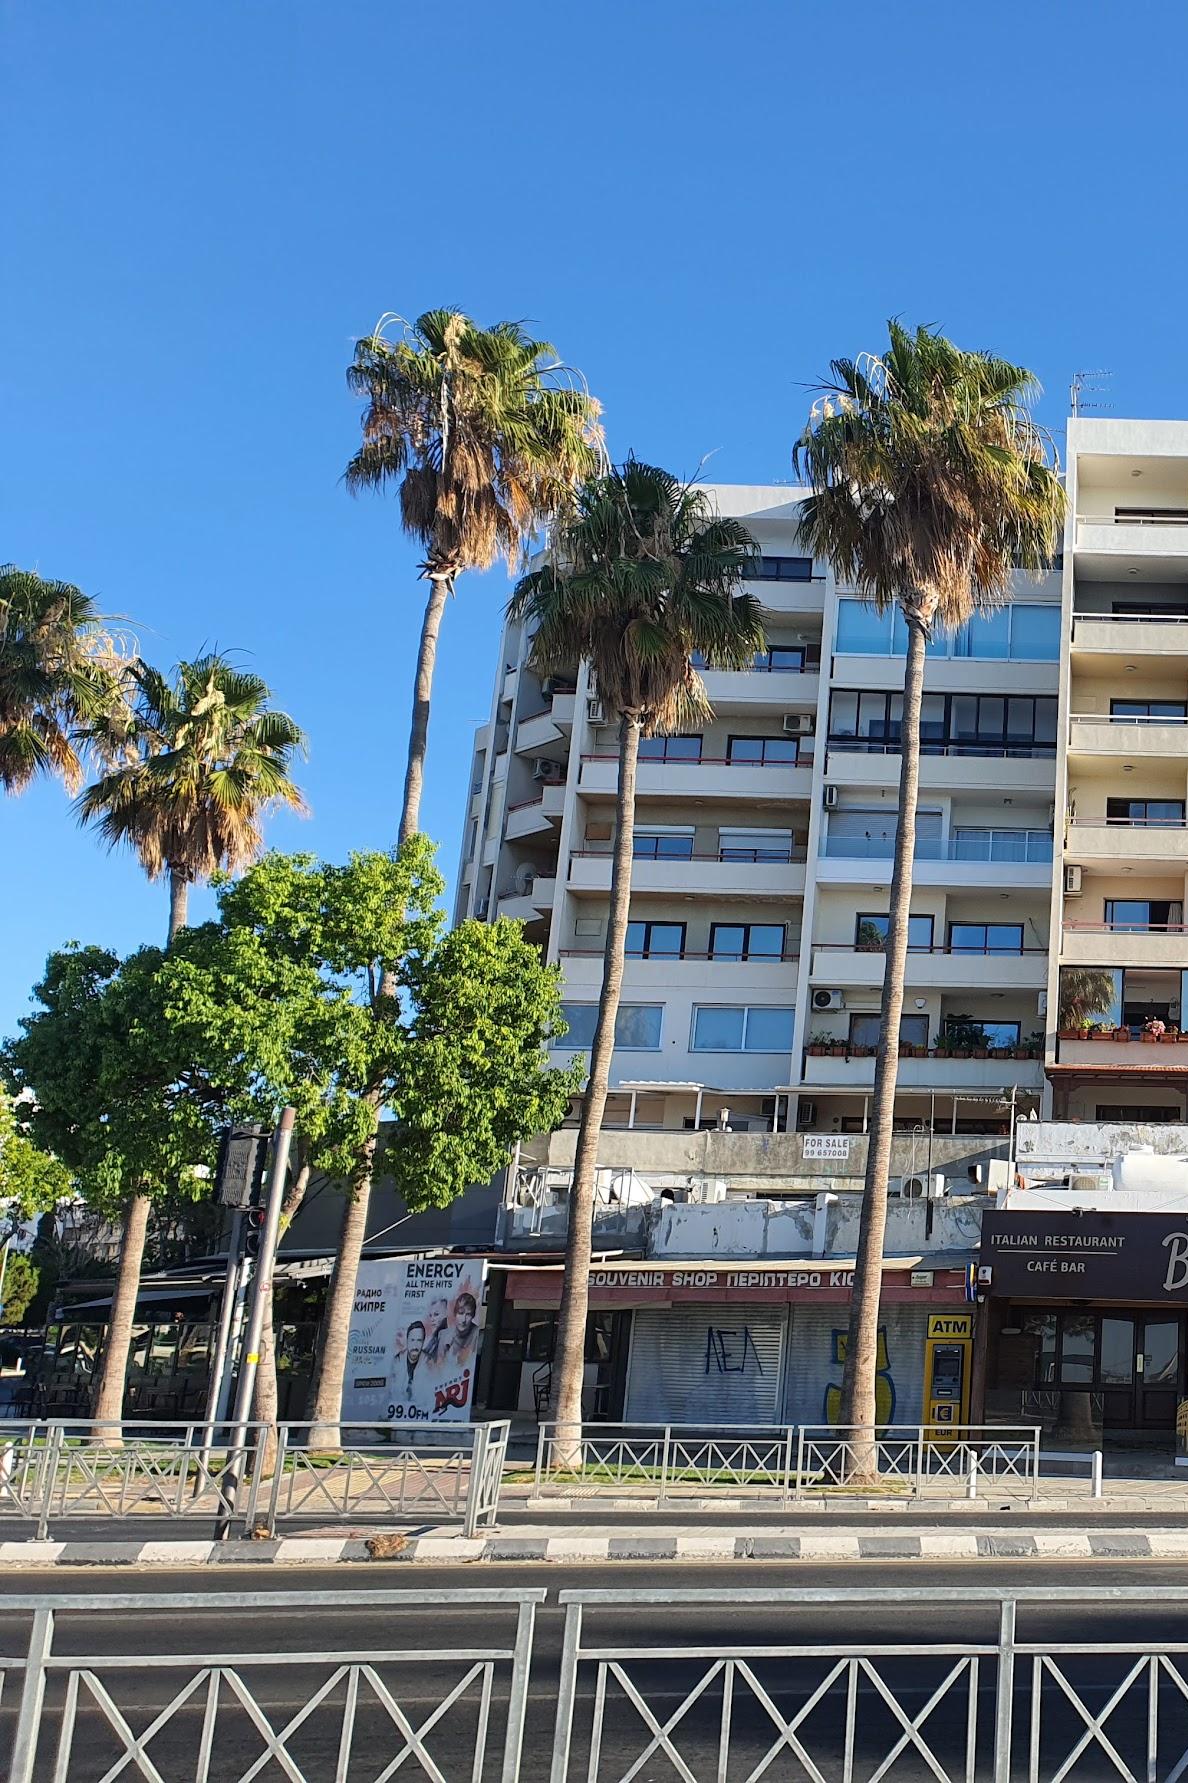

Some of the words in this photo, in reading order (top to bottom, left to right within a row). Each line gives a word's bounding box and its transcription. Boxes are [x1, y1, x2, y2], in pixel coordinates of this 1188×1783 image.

[805, 1138, 823, 1148] FOR
[825, 1138, 849, 1148] SALE
[991, 1234, 1038, 1246] ITALIAN
[1044, 1235, 1126, 1248] RESTAURANT
[406, 1263, 465, 1279] ENERGY
[1026, 1258, 1058, 1272] CAFÉ
[1060, 1262, 1086, 1273] BAR
[405, 1280, 419, 1288] ALL
[420, 1280, 435, 1288] THE
[435, 1280, 453, 1288] HITS
[588, 1271, 665, 1287] SOUVENIR
[671, 1271, 718, 1287] SHOP
[356, 1288, 383, 1298] РАДИО
[404, 1289, 426, 1299] FIRST
[353, 1301, 386, 1313] КИПРЕ
[932, 1320, 968, 1334] ATM
[352, 1345, 386, 1355] RUSSIAN
[433, 1369, 471, 1416] NRJ
[387, 1404, 429, 1420] 99.0FM
[935, 1429, 953, 1437] EUR
